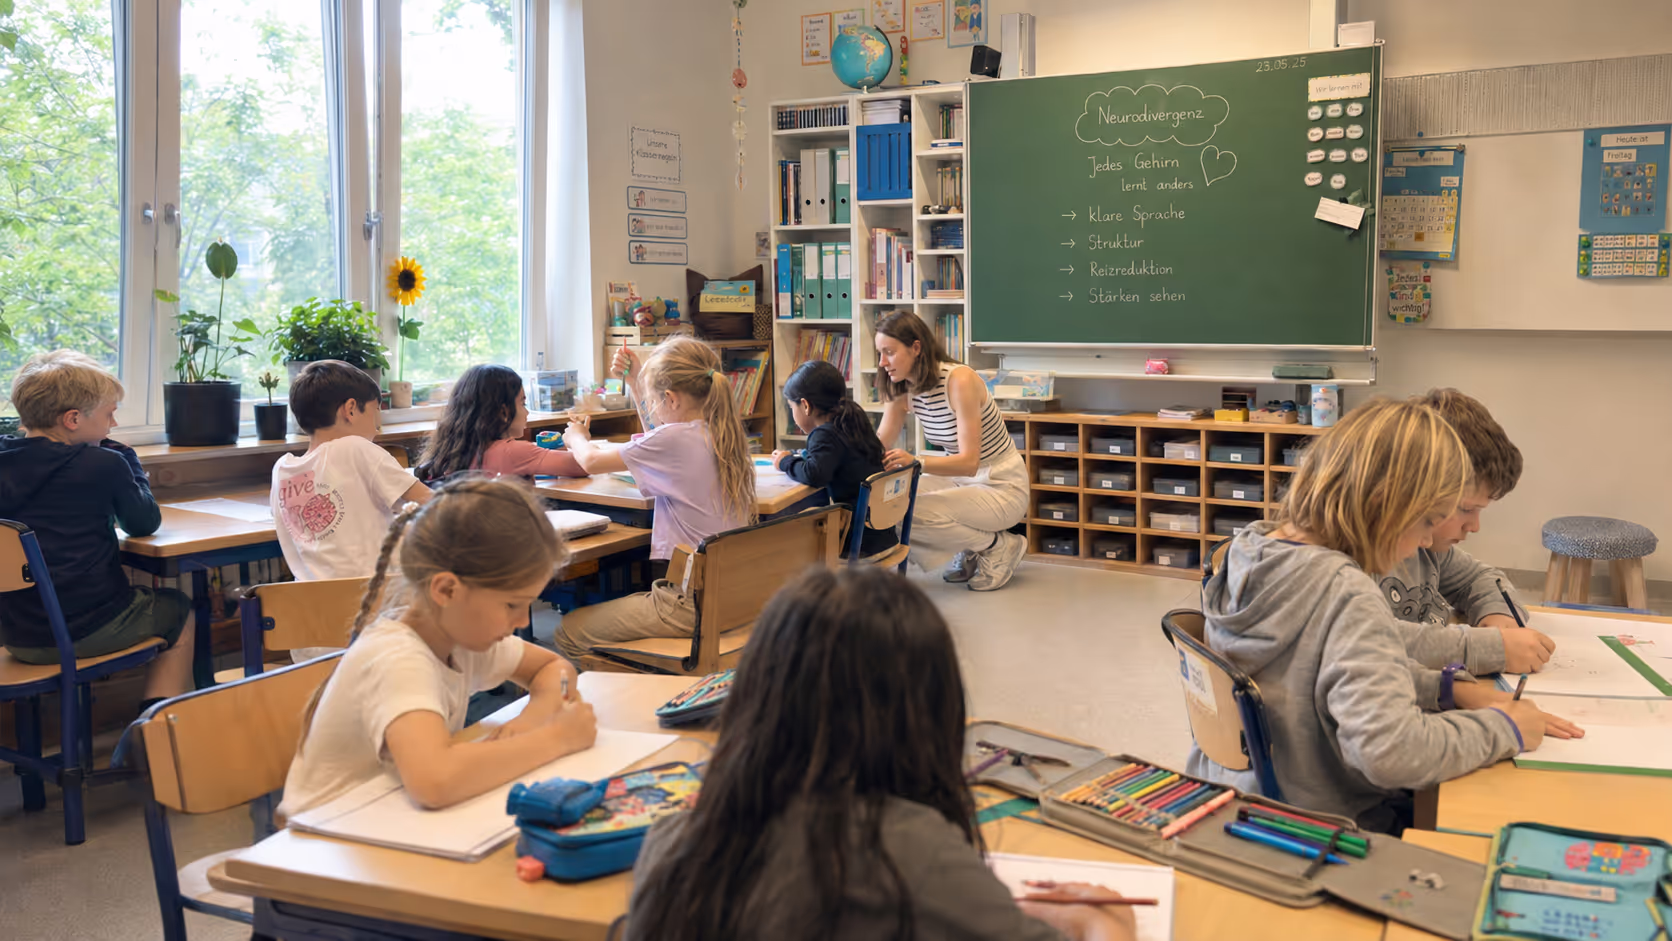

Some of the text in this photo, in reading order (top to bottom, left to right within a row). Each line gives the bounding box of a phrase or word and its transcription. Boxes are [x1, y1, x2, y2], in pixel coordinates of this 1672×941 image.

[1256, 57, 1307, 72] 23.05.25
[1098, 104, 1205, 127] Neurodivergenz
[1088, 152, 1180, 178] Jedes Gehirn
[1122, 177, 1194, 192] lernt anders
[1133, 202, 1185, 228] Sprache
[1088, 233, 1144, 250] Struktur
[1090, 260, 1173, 276] Reizreduktion
[1089, 287, 1185, 303] Stärken sehen
[279, 480, 315, 508] give
